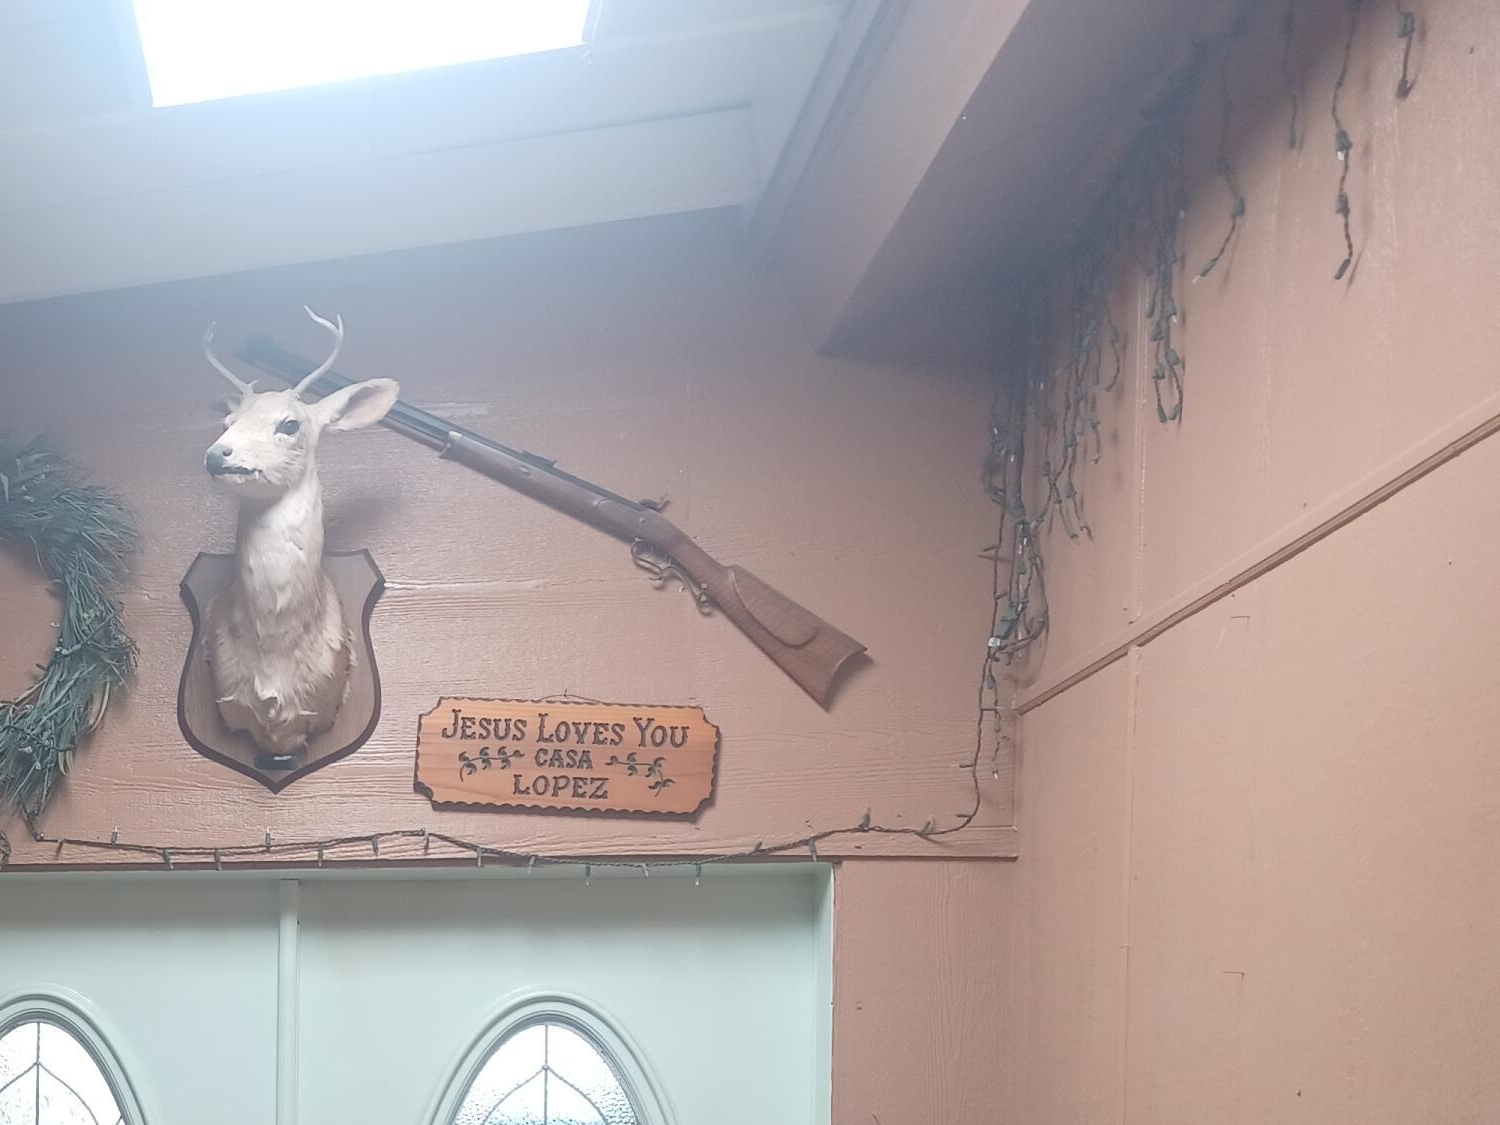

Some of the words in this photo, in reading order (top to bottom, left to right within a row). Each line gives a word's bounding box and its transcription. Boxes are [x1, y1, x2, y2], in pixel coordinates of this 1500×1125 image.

[442, 709, 527, 741] JESUS
[536, 713, 625, 746] LOVES
[633, 717, 689, 748] YOU
[534, 748, 593, 769] CASA
[513, 774, 609, 799] LOPEZ
